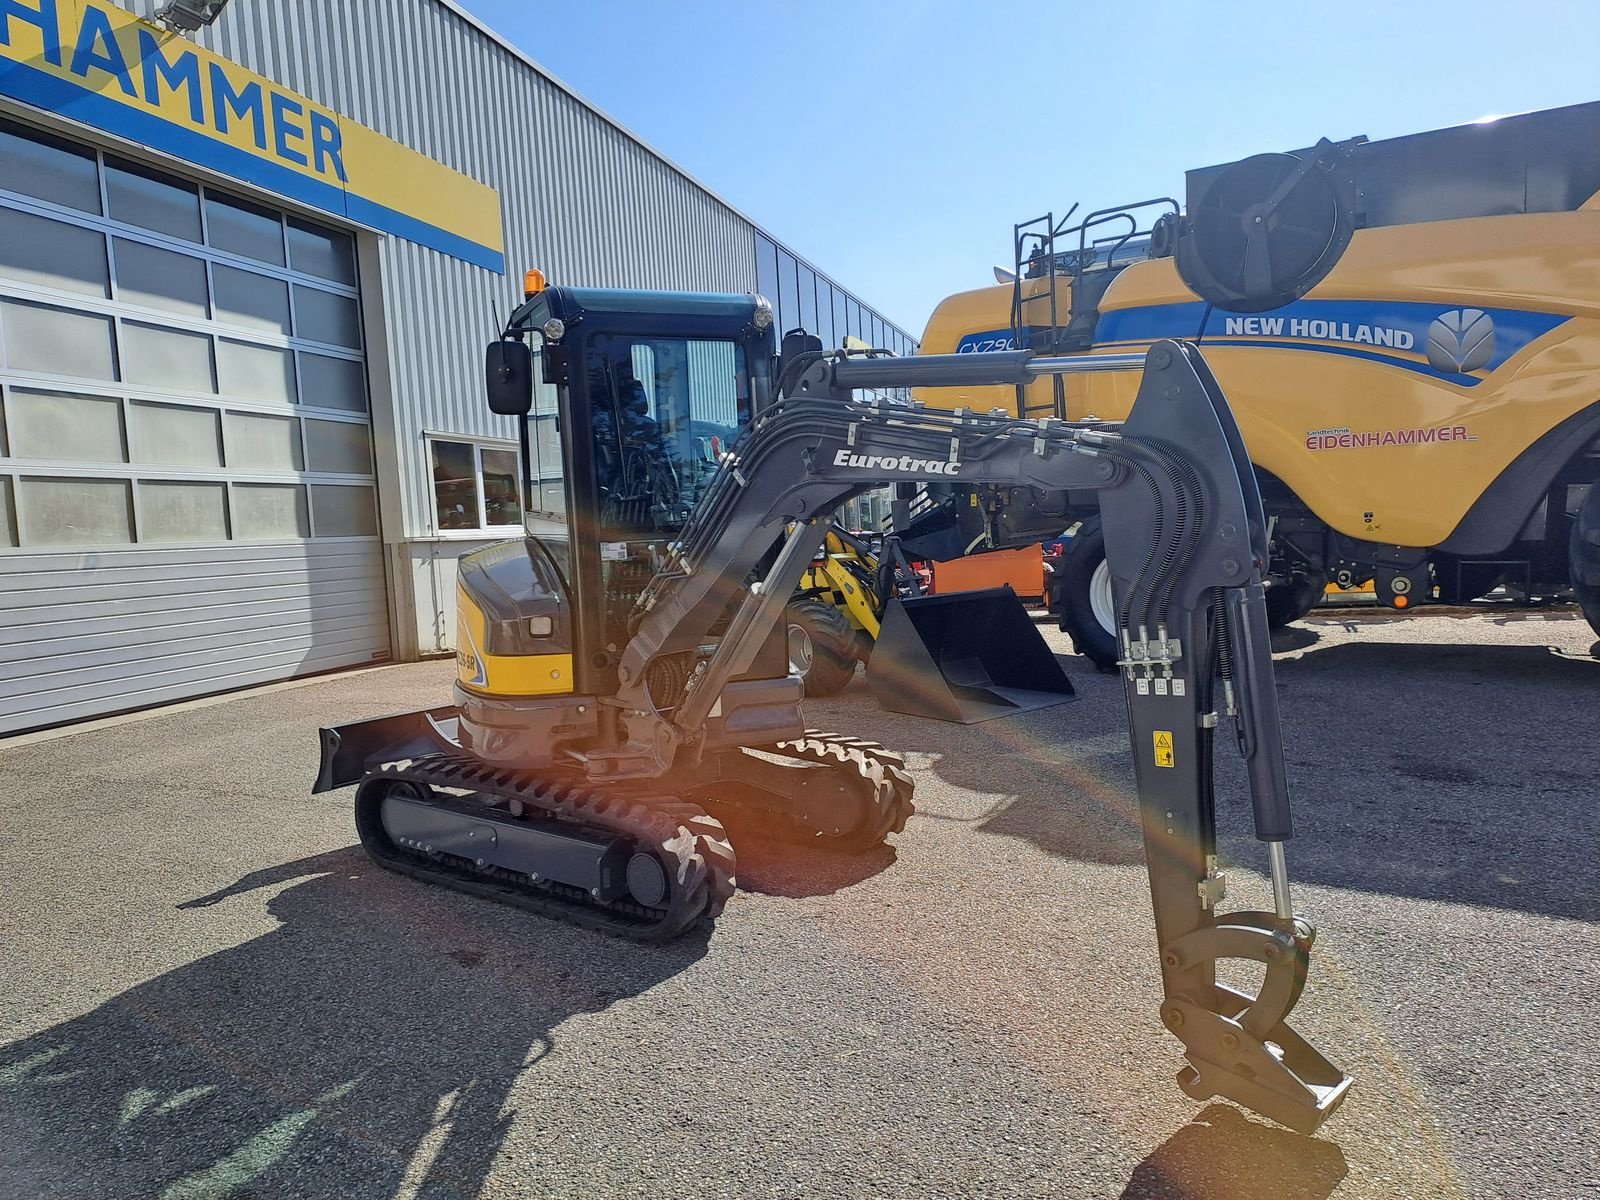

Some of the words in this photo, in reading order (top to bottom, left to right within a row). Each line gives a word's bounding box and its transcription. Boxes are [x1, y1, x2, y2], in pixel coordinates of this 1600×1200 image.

[1225, 317, 1284, 336] NEW
[1290, 318, 1414, 350] HOLLAND
[1306, 426, 1467, 450] EIDENHAMMER
[1307, 428, 1350, 436] Landtechnik
[833, 449, 962, 476] Eurotrac
